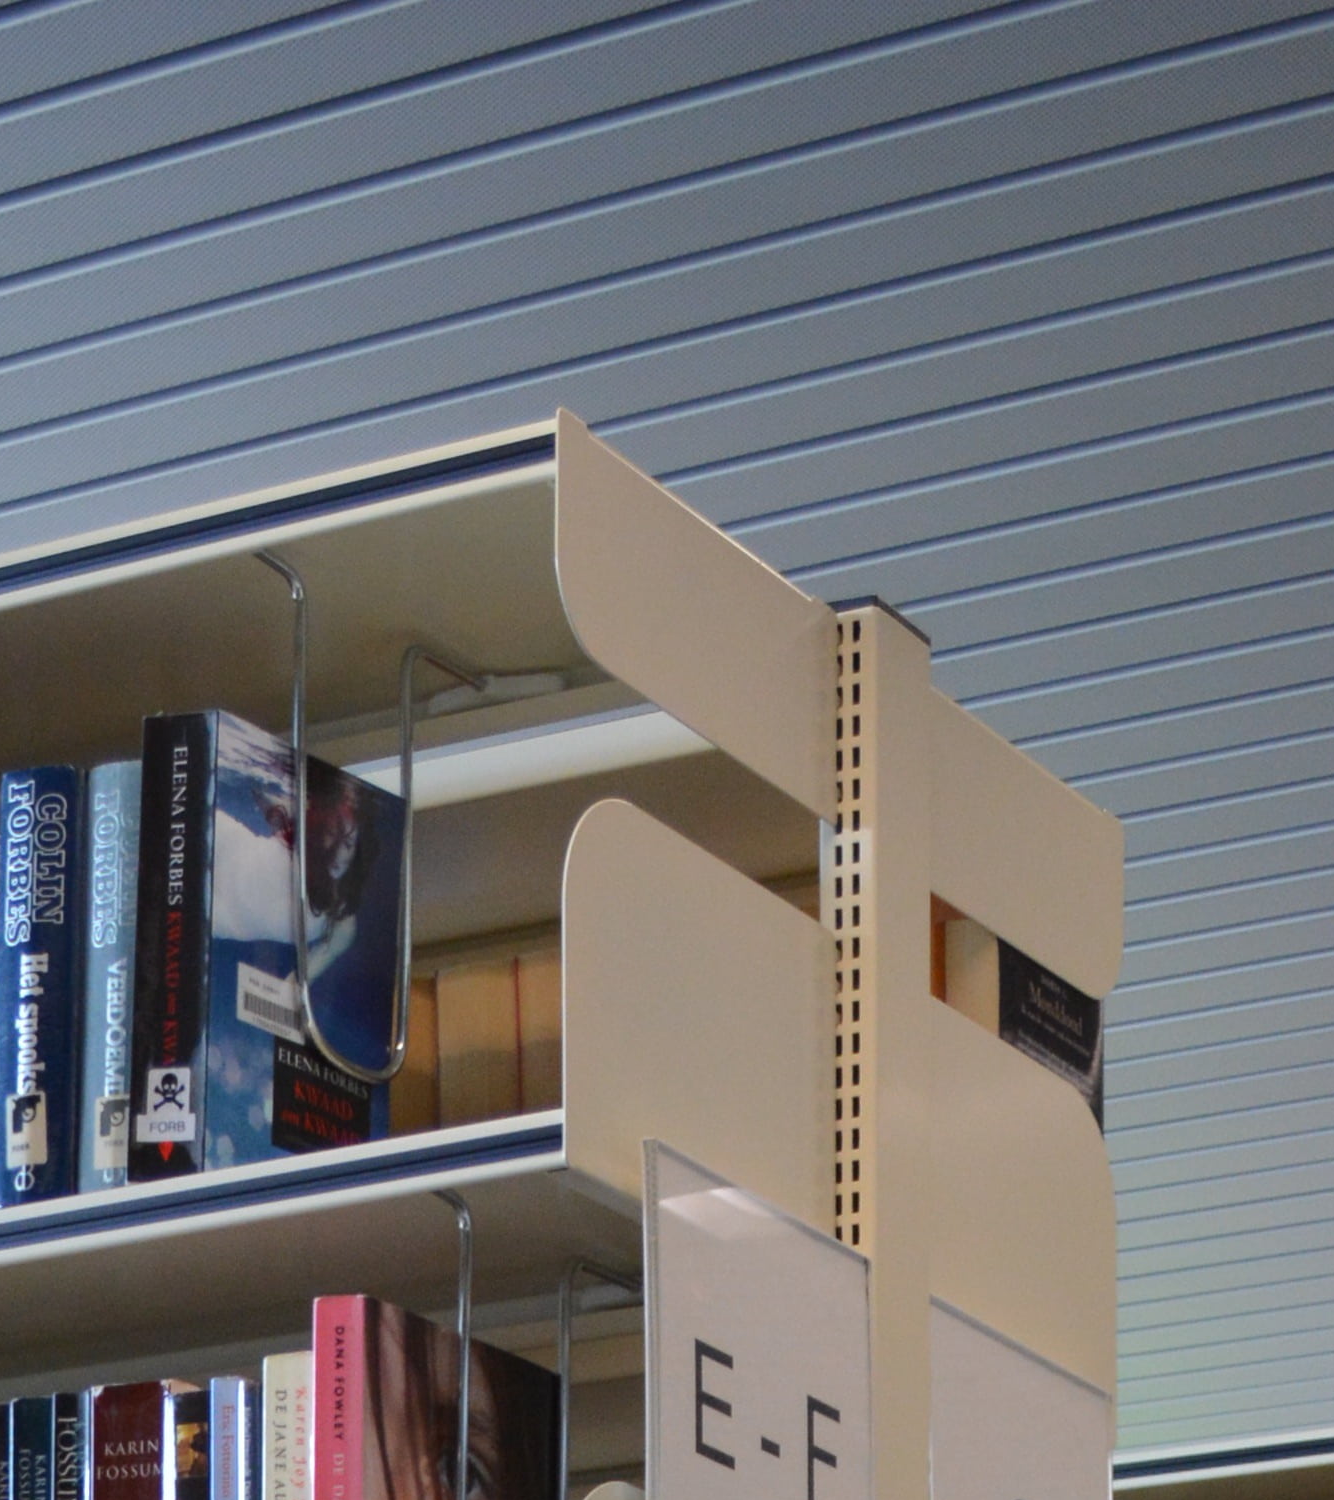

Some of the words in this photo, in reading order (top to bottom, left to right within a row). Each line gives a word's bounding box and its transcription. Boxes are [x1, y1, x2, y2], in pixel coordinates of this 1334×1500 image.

[172, 746, 189, 816] ELENA
[5, 780, 34, 946] FORBES
[33, 793, 66, 924] COLIN
[168, 823, 185, 905] FORBES
[20, 952, 49, 996] Het
[149, 1120, 185, 1133] FORB
[334, 1326, 345, 1371] DANA
[334, 1377, 345, 1441] FOWLEY
[97, 1461, 163, 1480] FOSSUM
[105, 1439, 159, 1457] KARIN
